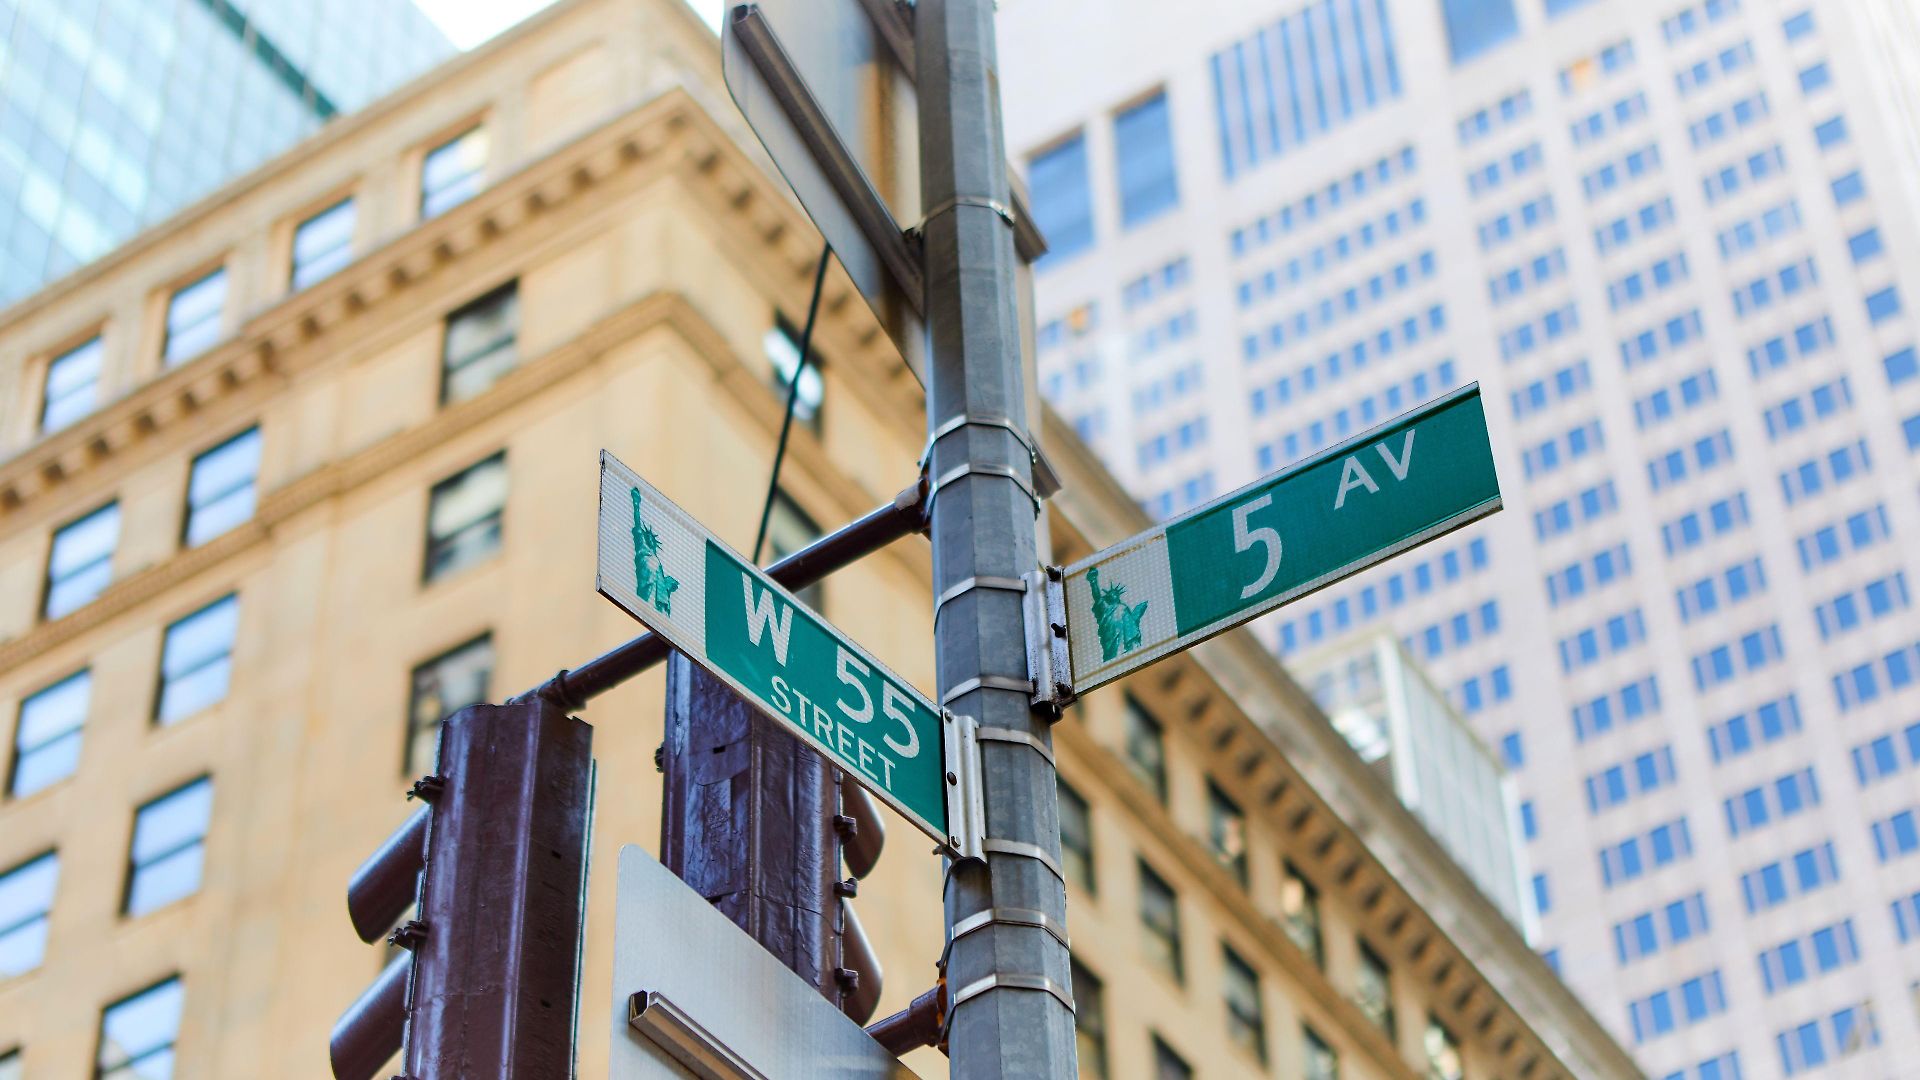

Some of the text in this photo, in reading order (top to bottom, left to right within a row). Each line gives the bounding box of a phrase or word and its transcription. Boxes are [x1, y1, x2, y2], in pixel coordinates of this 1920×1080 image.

[1232, 430, 1416, 600] 5 AV
[742, 572, 920, 759] W 55
[771, 677, 896, 791] STREET
